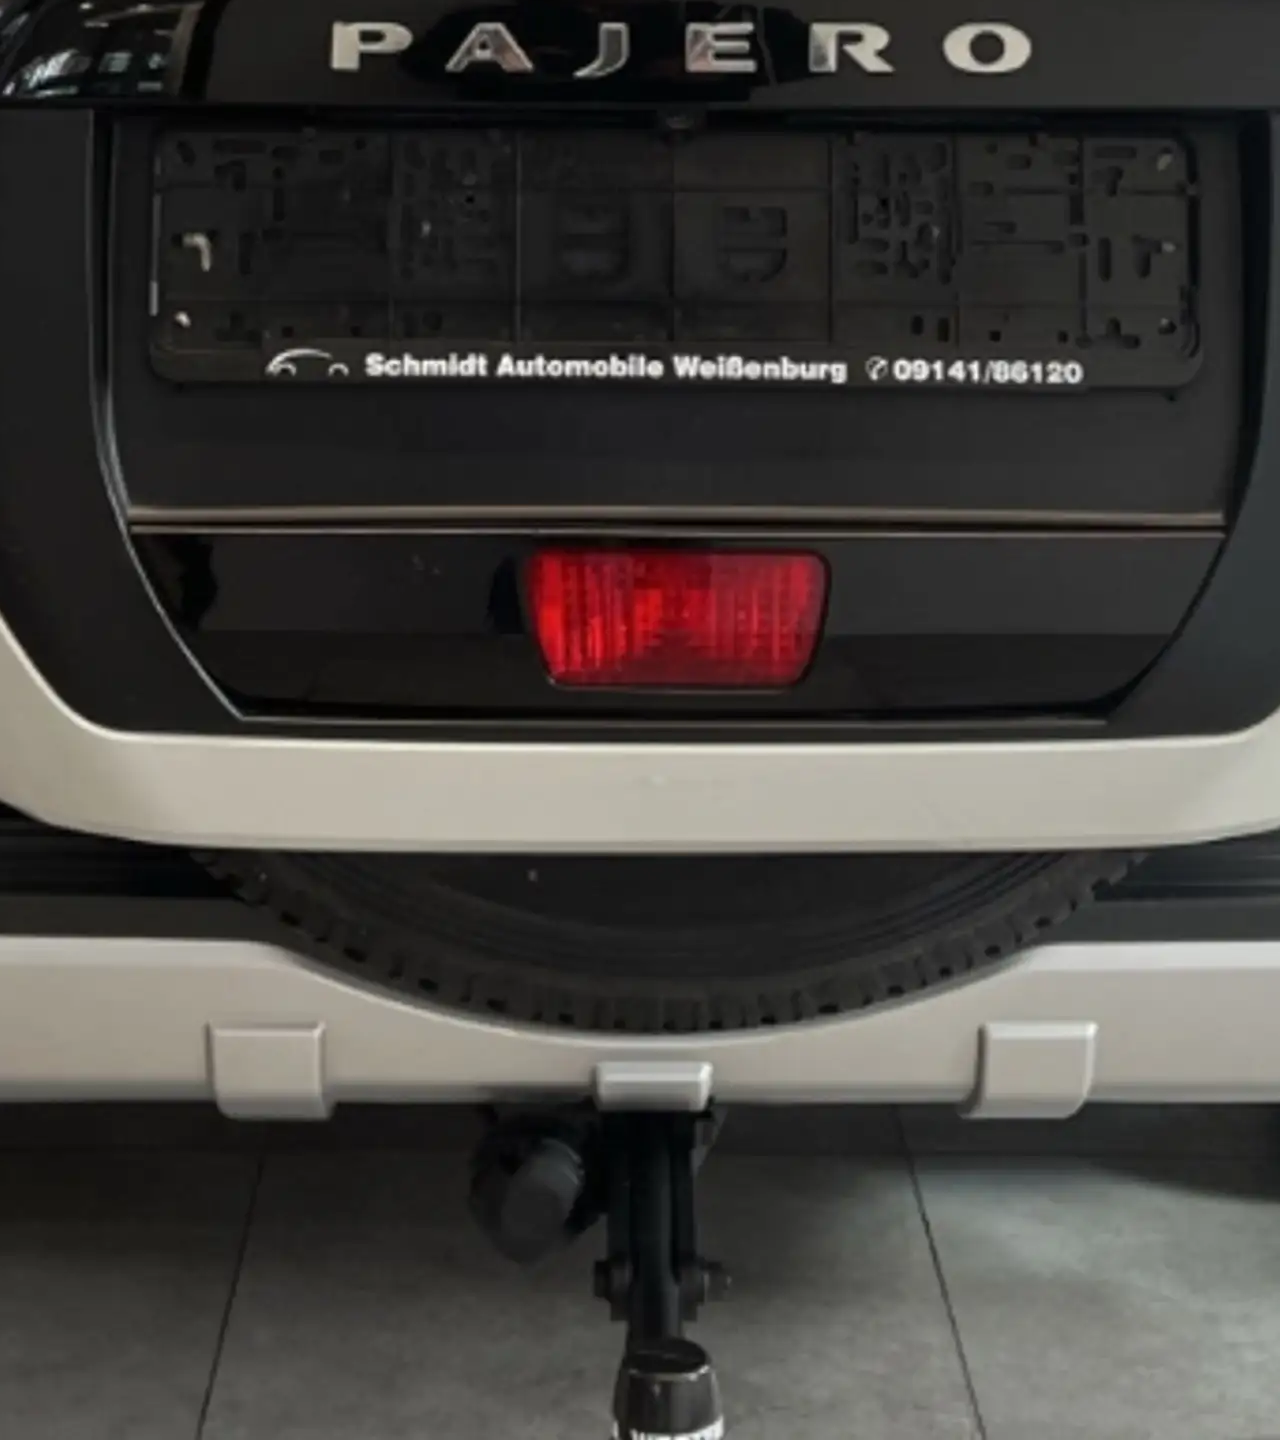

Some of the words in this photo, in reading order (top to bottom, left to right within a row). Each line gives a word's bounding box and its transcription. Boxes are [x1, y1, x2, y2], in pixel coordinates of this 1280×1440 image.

[330, 20, 1033, 78] PAJERO
[364, 352, 488, 378] Schmidt
[496, 353, 664, 380] Automobile
[673, 354, 848, 385] Weißenburg
